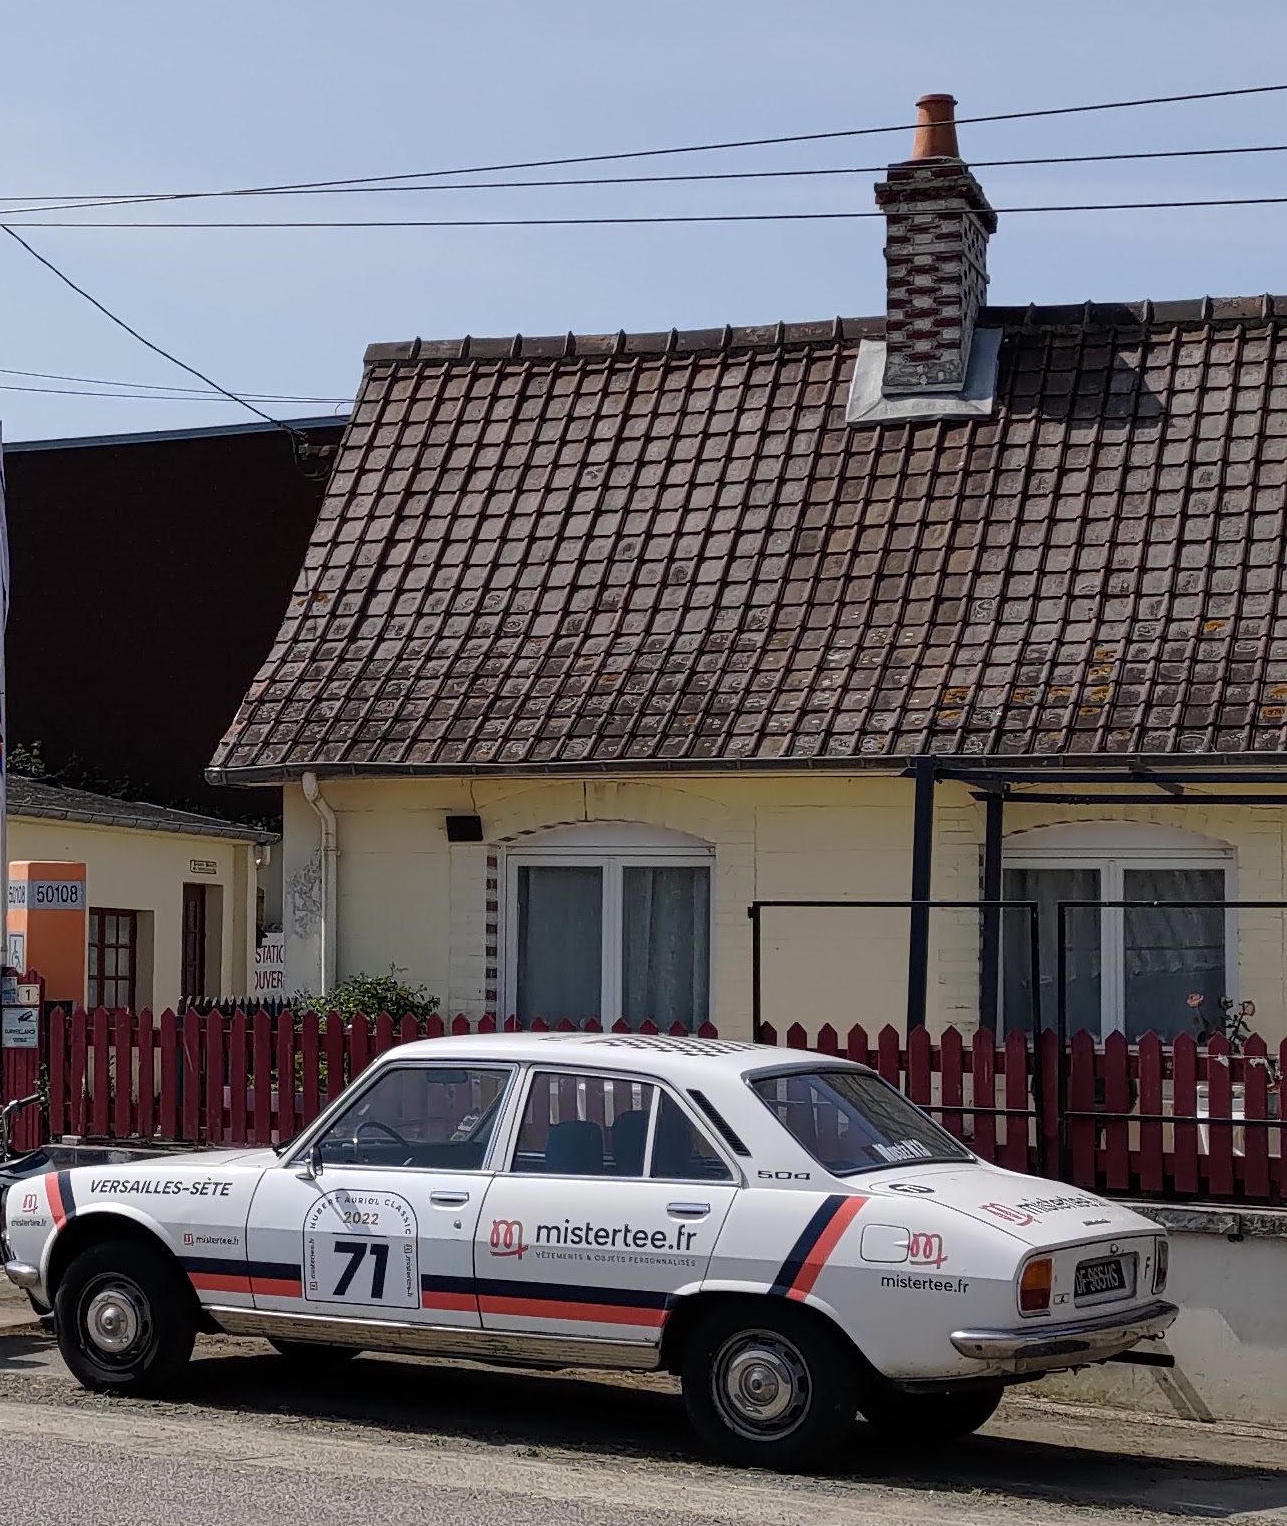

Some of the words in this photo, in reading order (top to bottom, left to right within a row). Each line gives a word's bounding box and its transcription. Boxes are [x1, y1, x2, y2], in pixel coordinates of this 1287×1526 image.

[9, 886, 26, 904] 50108
[36, 885, 78, 903] 50108
[25, 989, 31, 1002] 1
[757, 1170, 811, 1180] 504
[90, 1177, 233, 1197] VERSAILLES-SÈTE
[342, 1211, 379, 1225] 2022
[535, 1219, 697, 1251] mistertee.fr
[594, 1254, 626, 1263] OBJETS
[332, 1240, 390, 1299] 71
[881, 1274, 970, 1294] mistertee.fr
